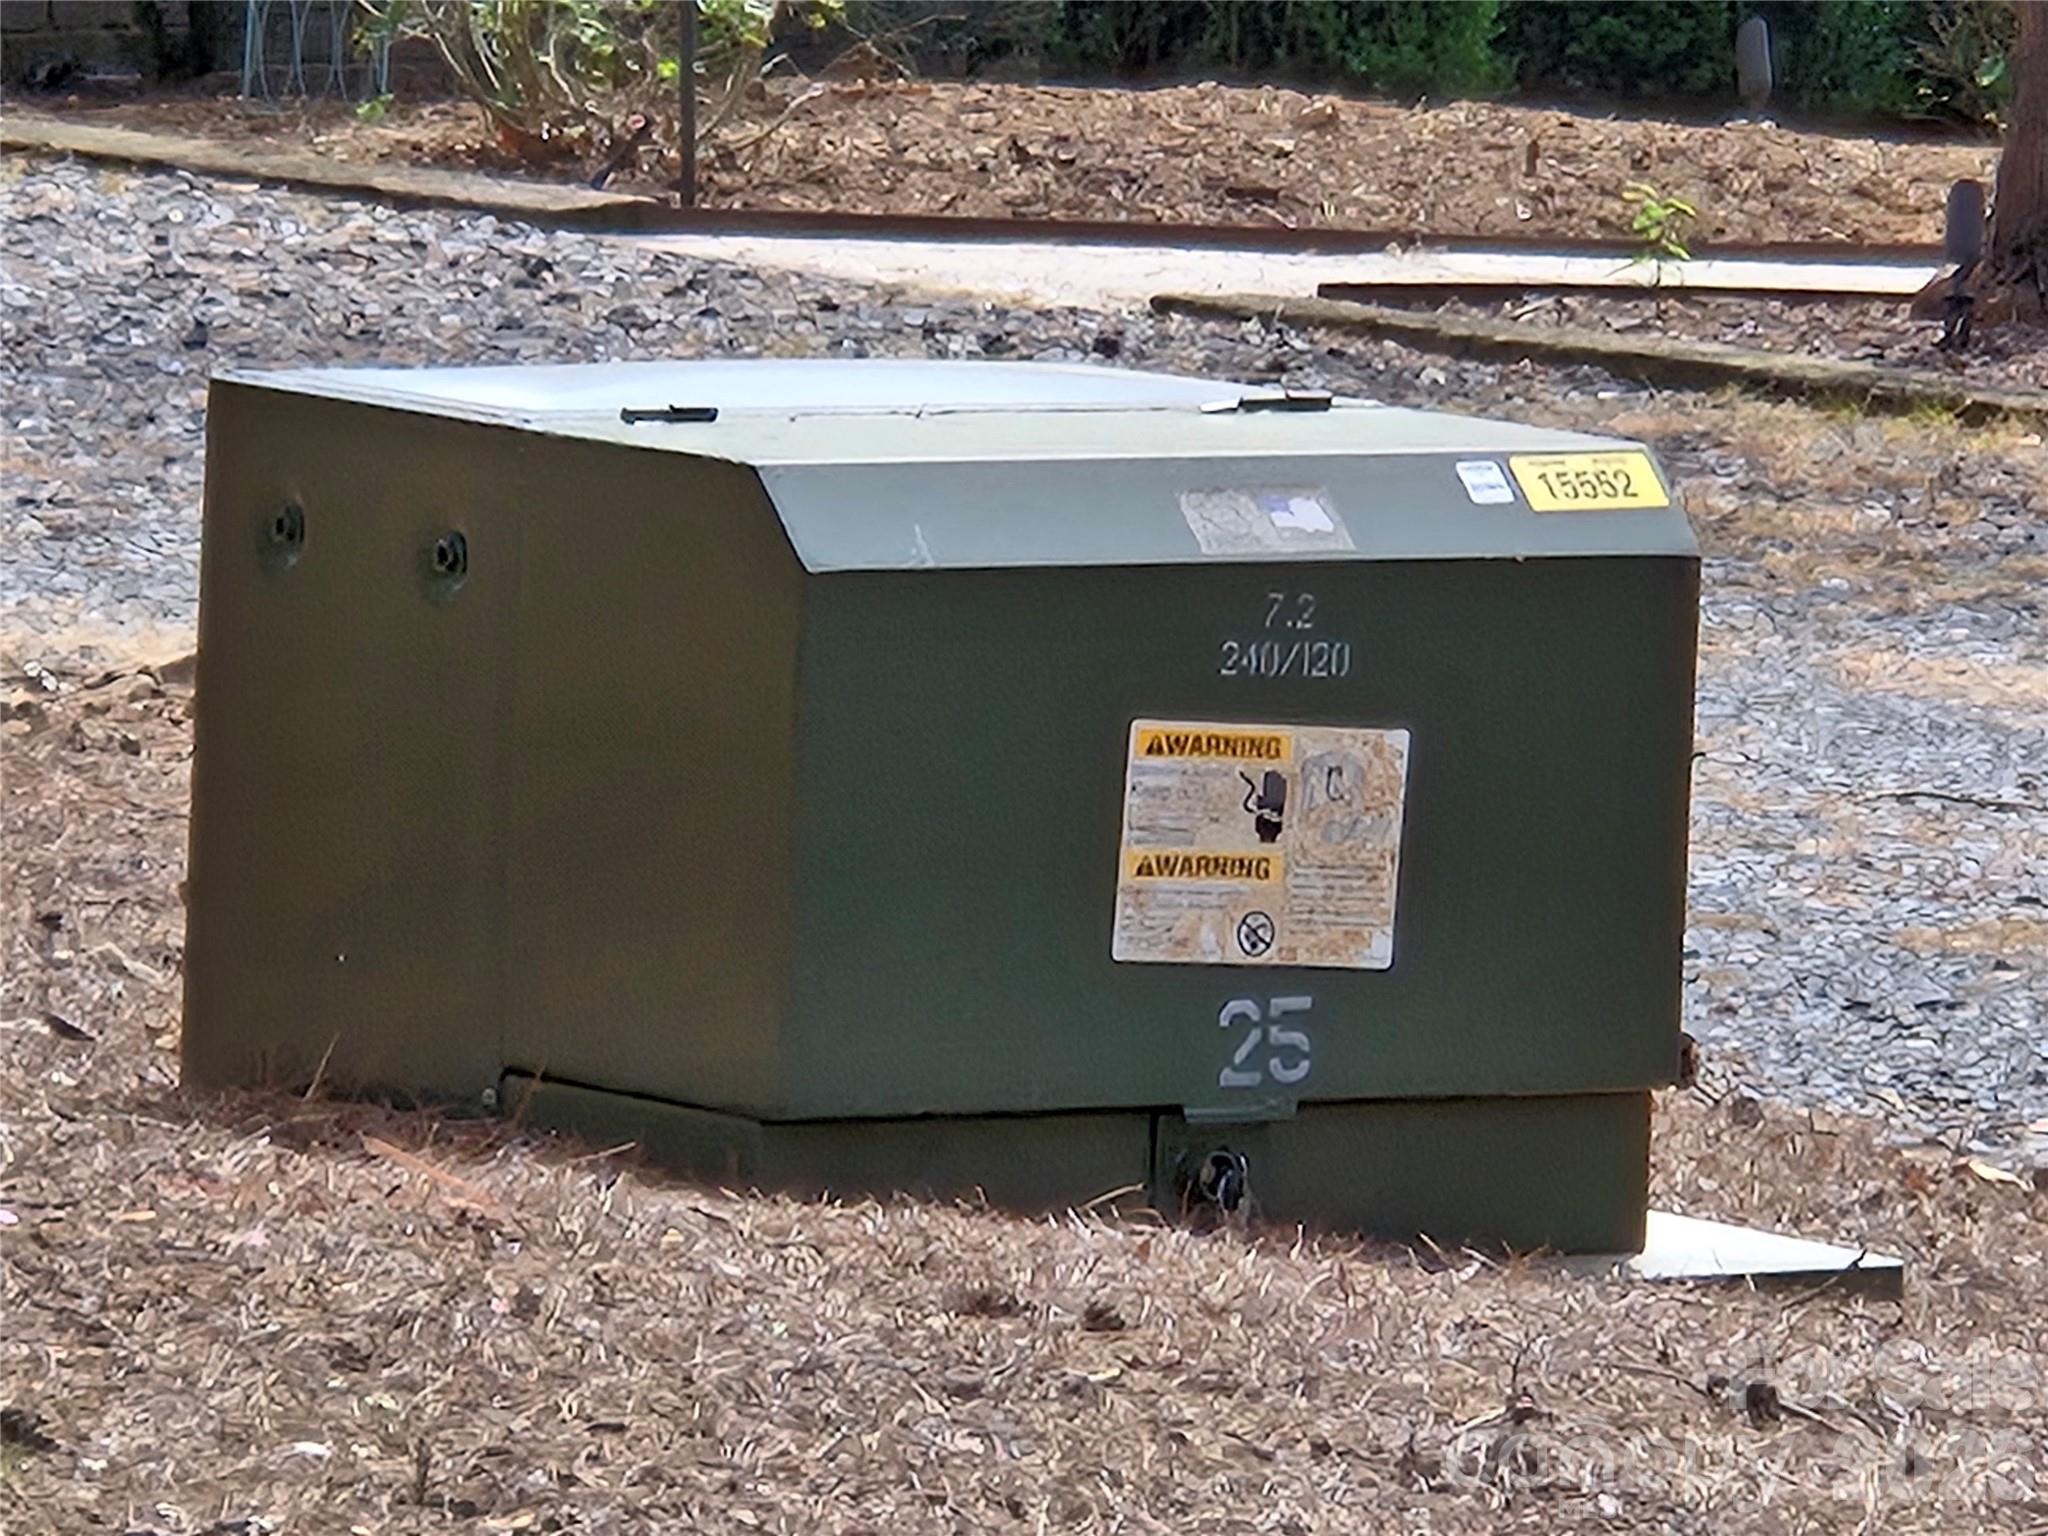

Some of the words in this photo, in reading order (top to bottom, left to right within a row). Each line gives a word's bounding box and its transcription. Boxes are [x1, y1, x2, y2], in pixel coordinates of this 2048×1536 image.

[1537, 469, 1639, 500] 15552
[1265, 591, 1317, 629] 7.2
[1220, 641, 1350, 677] 240/120
[1163, 734, 1281, 759] WARNING
[1153, 854, 1270, 880] WARNING
[1218, 996, 1313, 1087] 25
